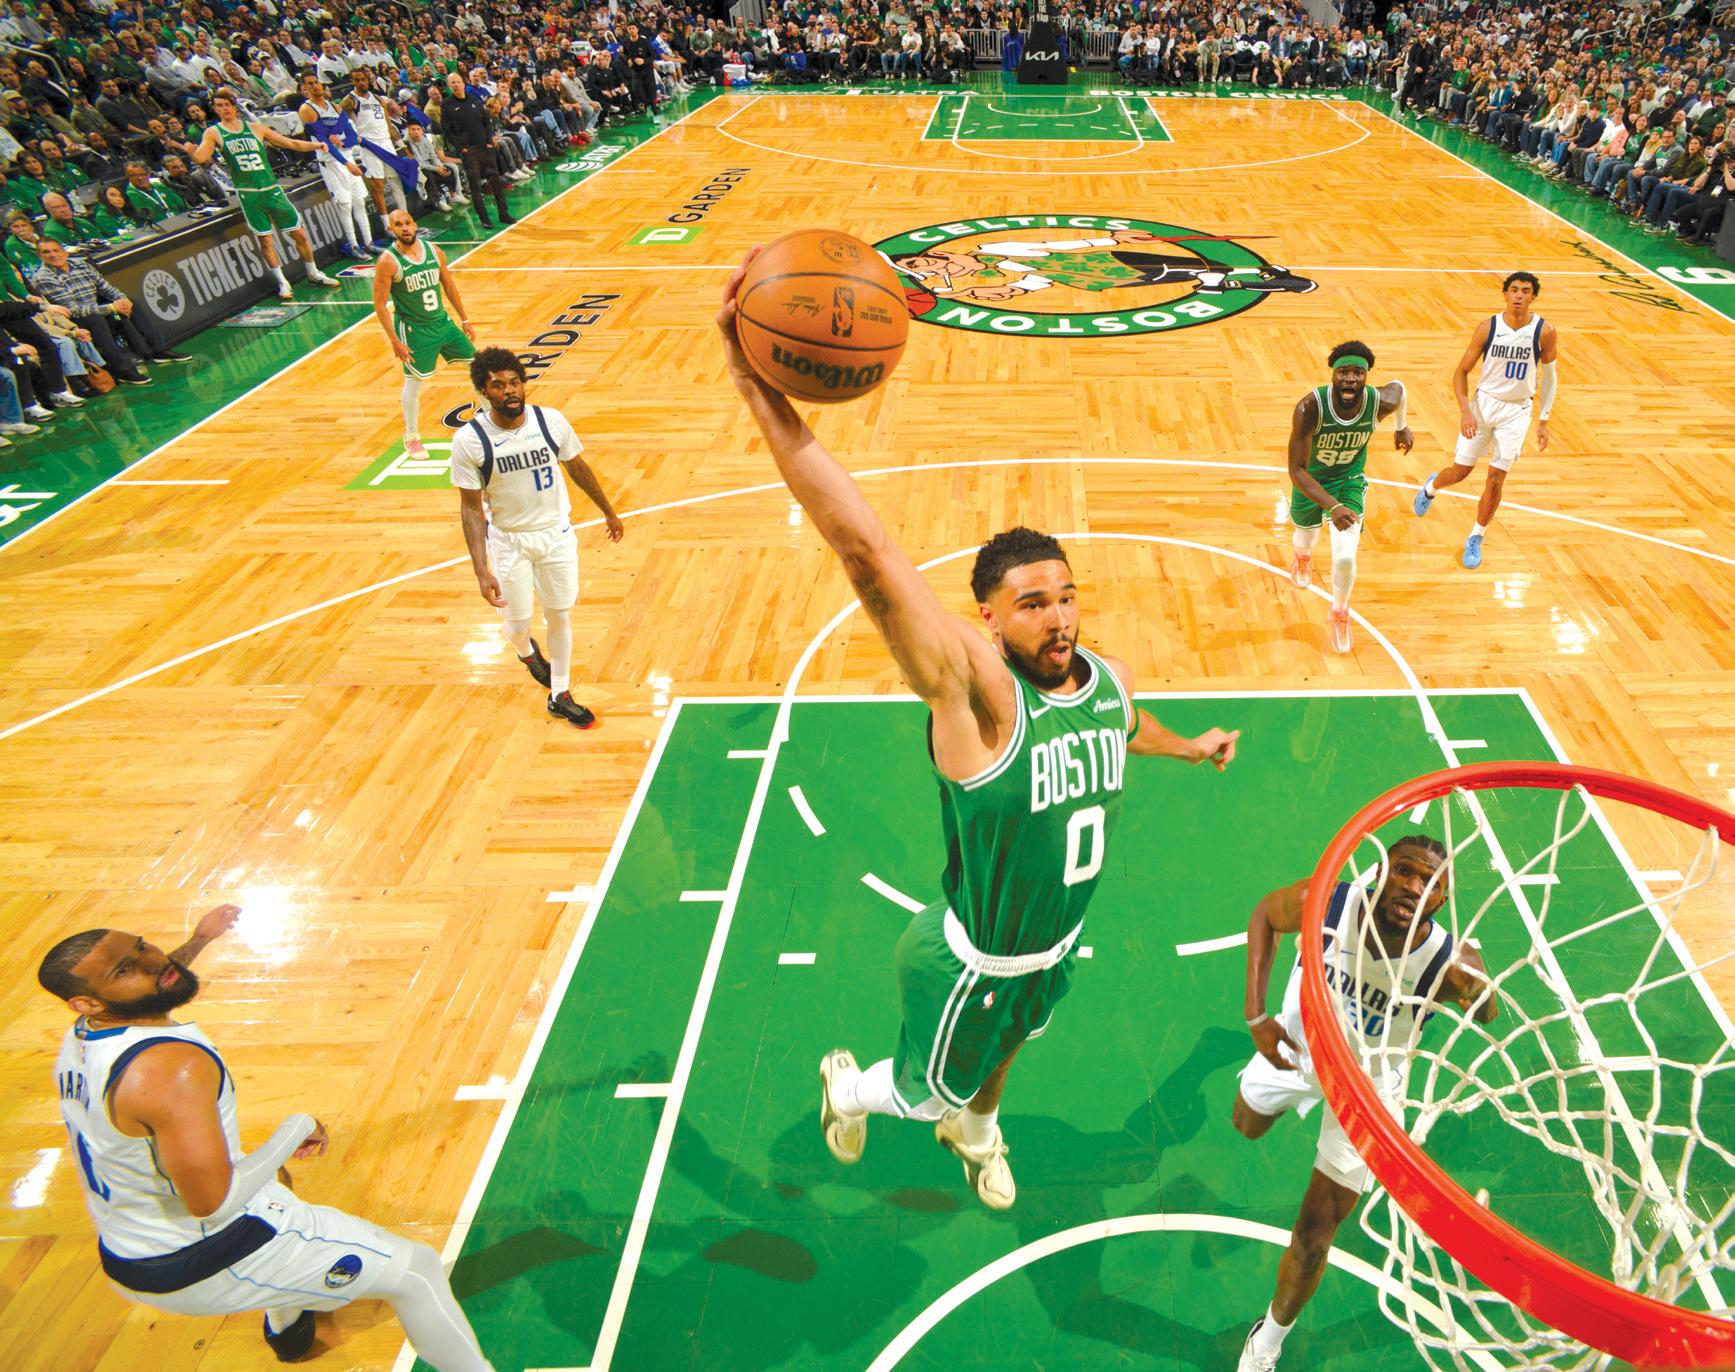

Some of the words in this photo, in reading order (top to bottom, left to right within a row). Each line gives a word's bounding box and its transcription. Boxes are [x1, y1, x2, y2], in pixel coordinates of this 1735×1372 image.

[1088, 90, 1218, 98] BOSTON
[1230, 91, 1348, 101] CELTICS
[225, 137, 261, 156] BOSTON
[234, 152, 267, 172] 52
[666, 167, 752, 224] GARDEN
[908, 216, 1133, 244] CELTICS
[176, 233, 264, 307] TICKETS
[422, 289, 439, 312] 9
[936, 300, 1225, 335] BOSTON
[1491, 344, 1532, 360] DALLAS
[1504, 361, 1529, 381] 00
[1316, 431, 1371, 449] BOSTON
[496, 447, 551, 474] DALLAS
[531, 466, 555, 492] 13
[1030, 728, 1127, 814] BOSTON
[1062, 804, 1106, 888] 0
